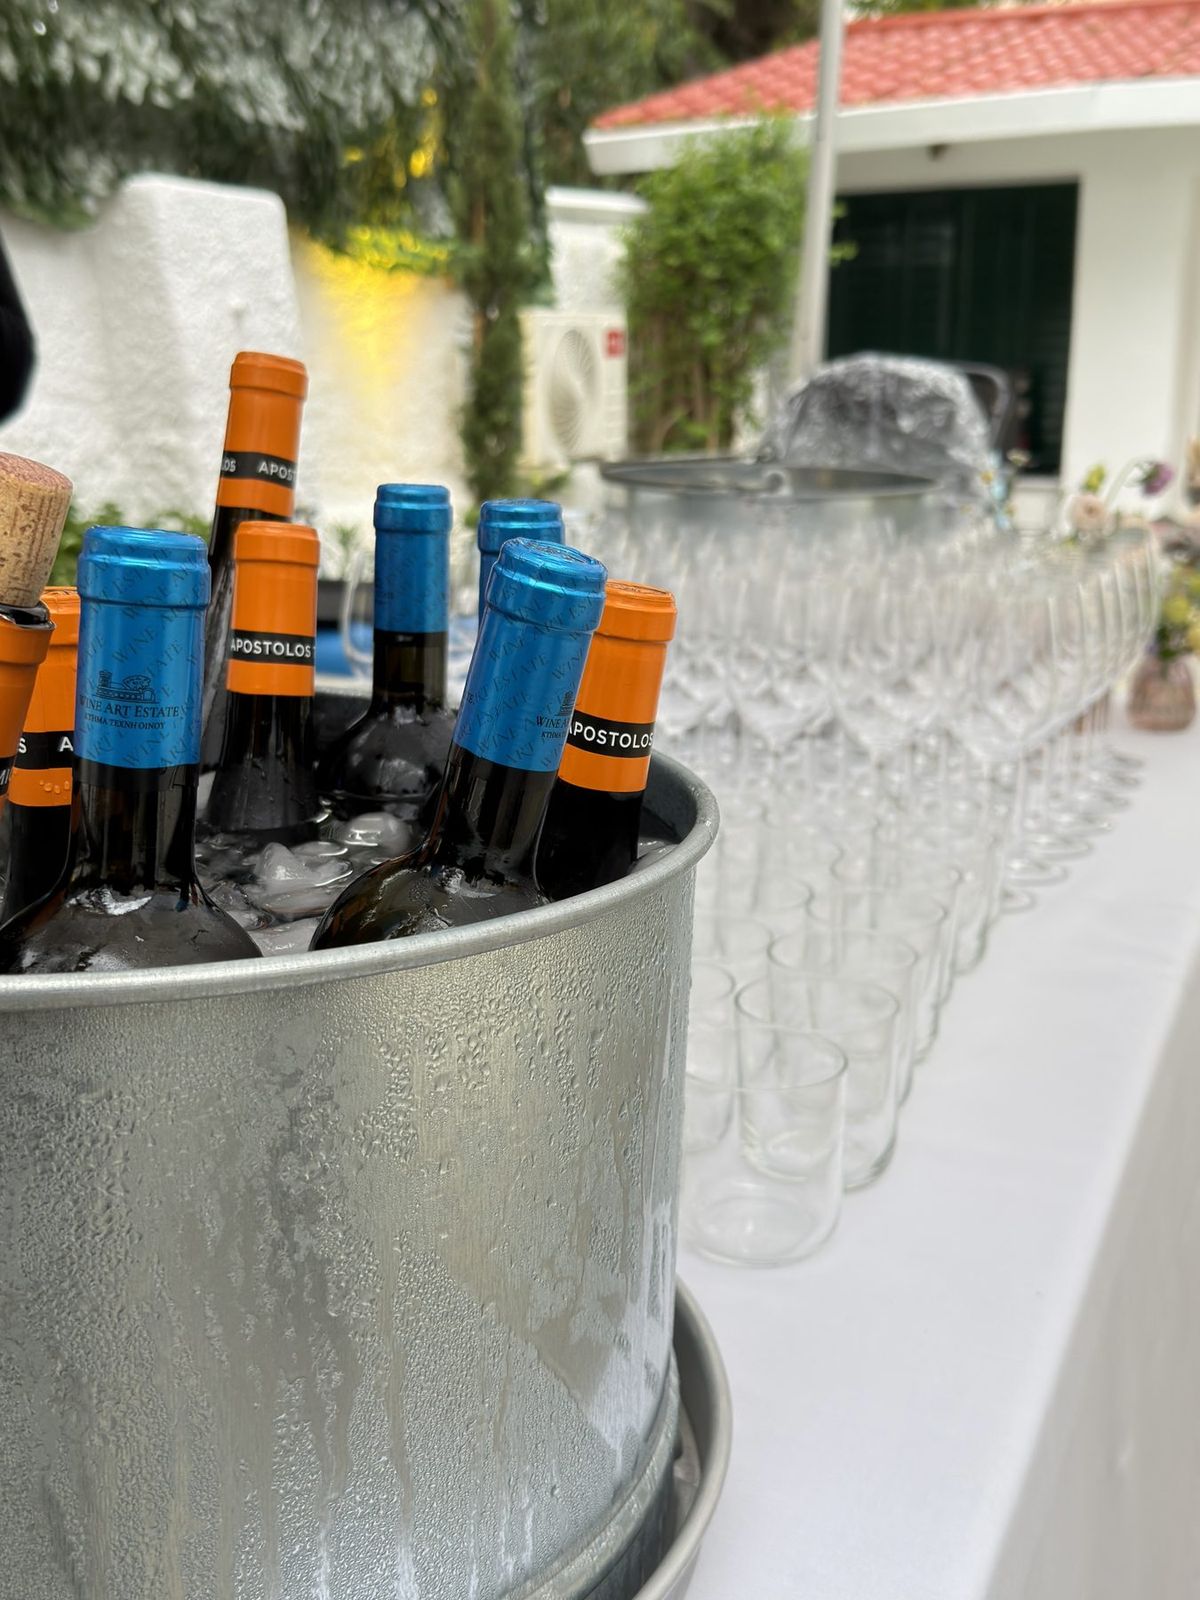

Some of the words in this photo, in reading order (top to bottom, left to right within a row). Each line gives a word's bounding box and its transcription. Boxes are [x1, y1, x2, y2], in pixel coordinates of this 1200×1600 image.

[231, 638, 311, 658] APOSTOLOS
[103, 701, 132, 719] ART
[135, 704, 179, 718] ESTATE
